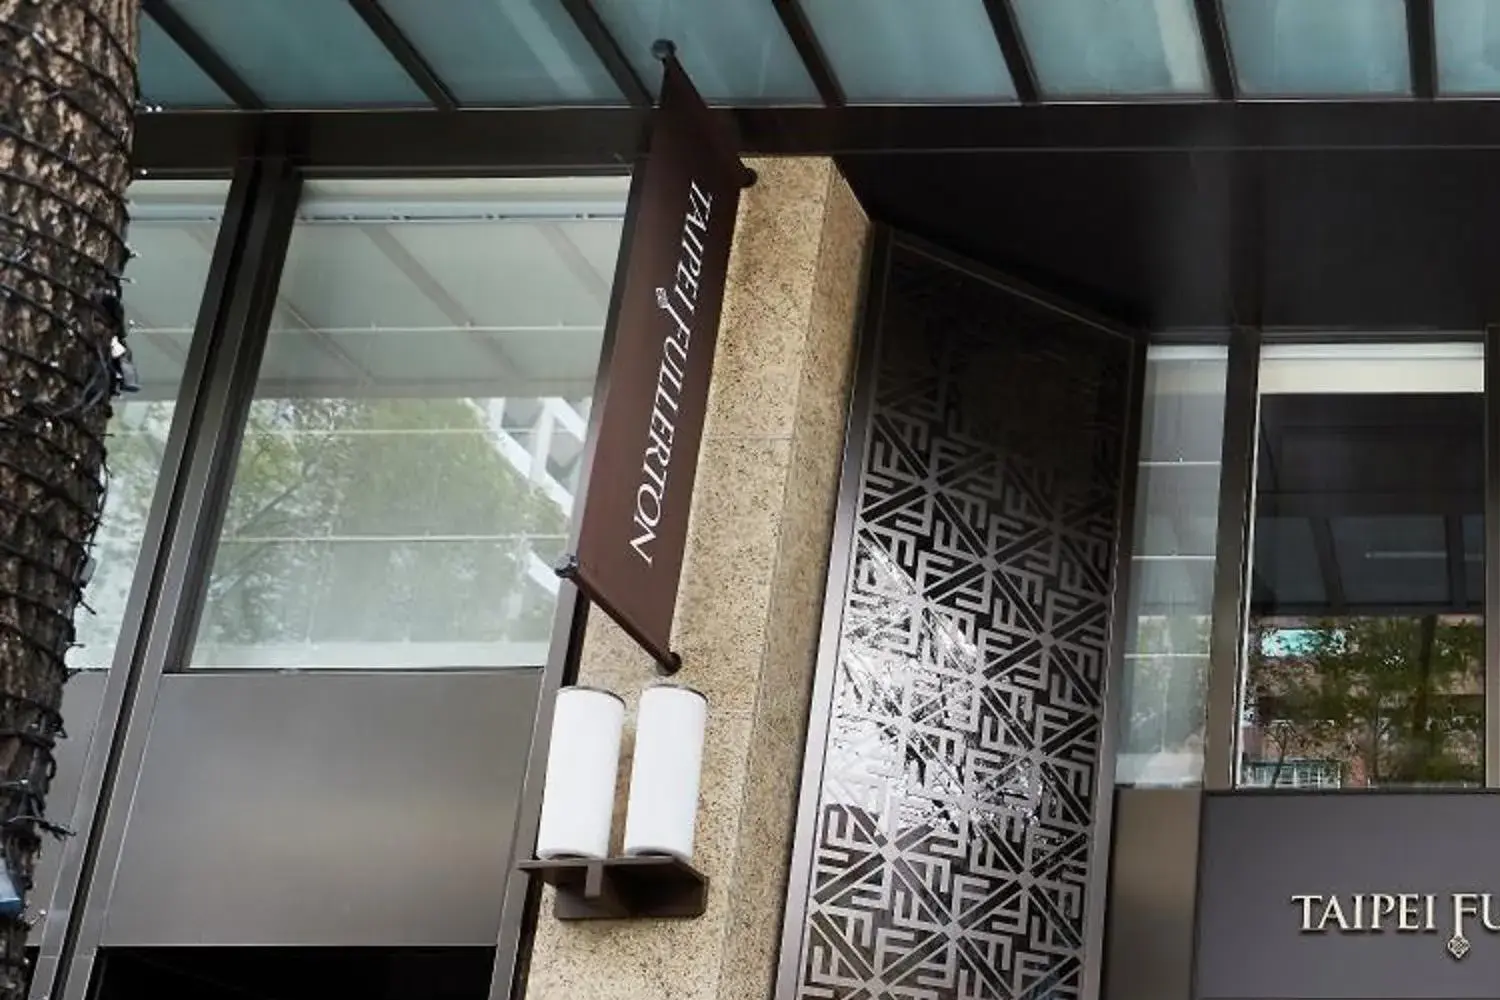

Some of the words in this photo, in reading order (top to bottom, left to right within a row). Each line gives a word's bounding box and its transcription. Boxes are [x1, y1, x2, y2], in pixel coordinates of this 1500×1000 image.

[675, 180, 713, 314] TAIPEI
[630, 288, 691, 566] FULLERTON
[1291, 894, 1438, 931] TAIPEI
